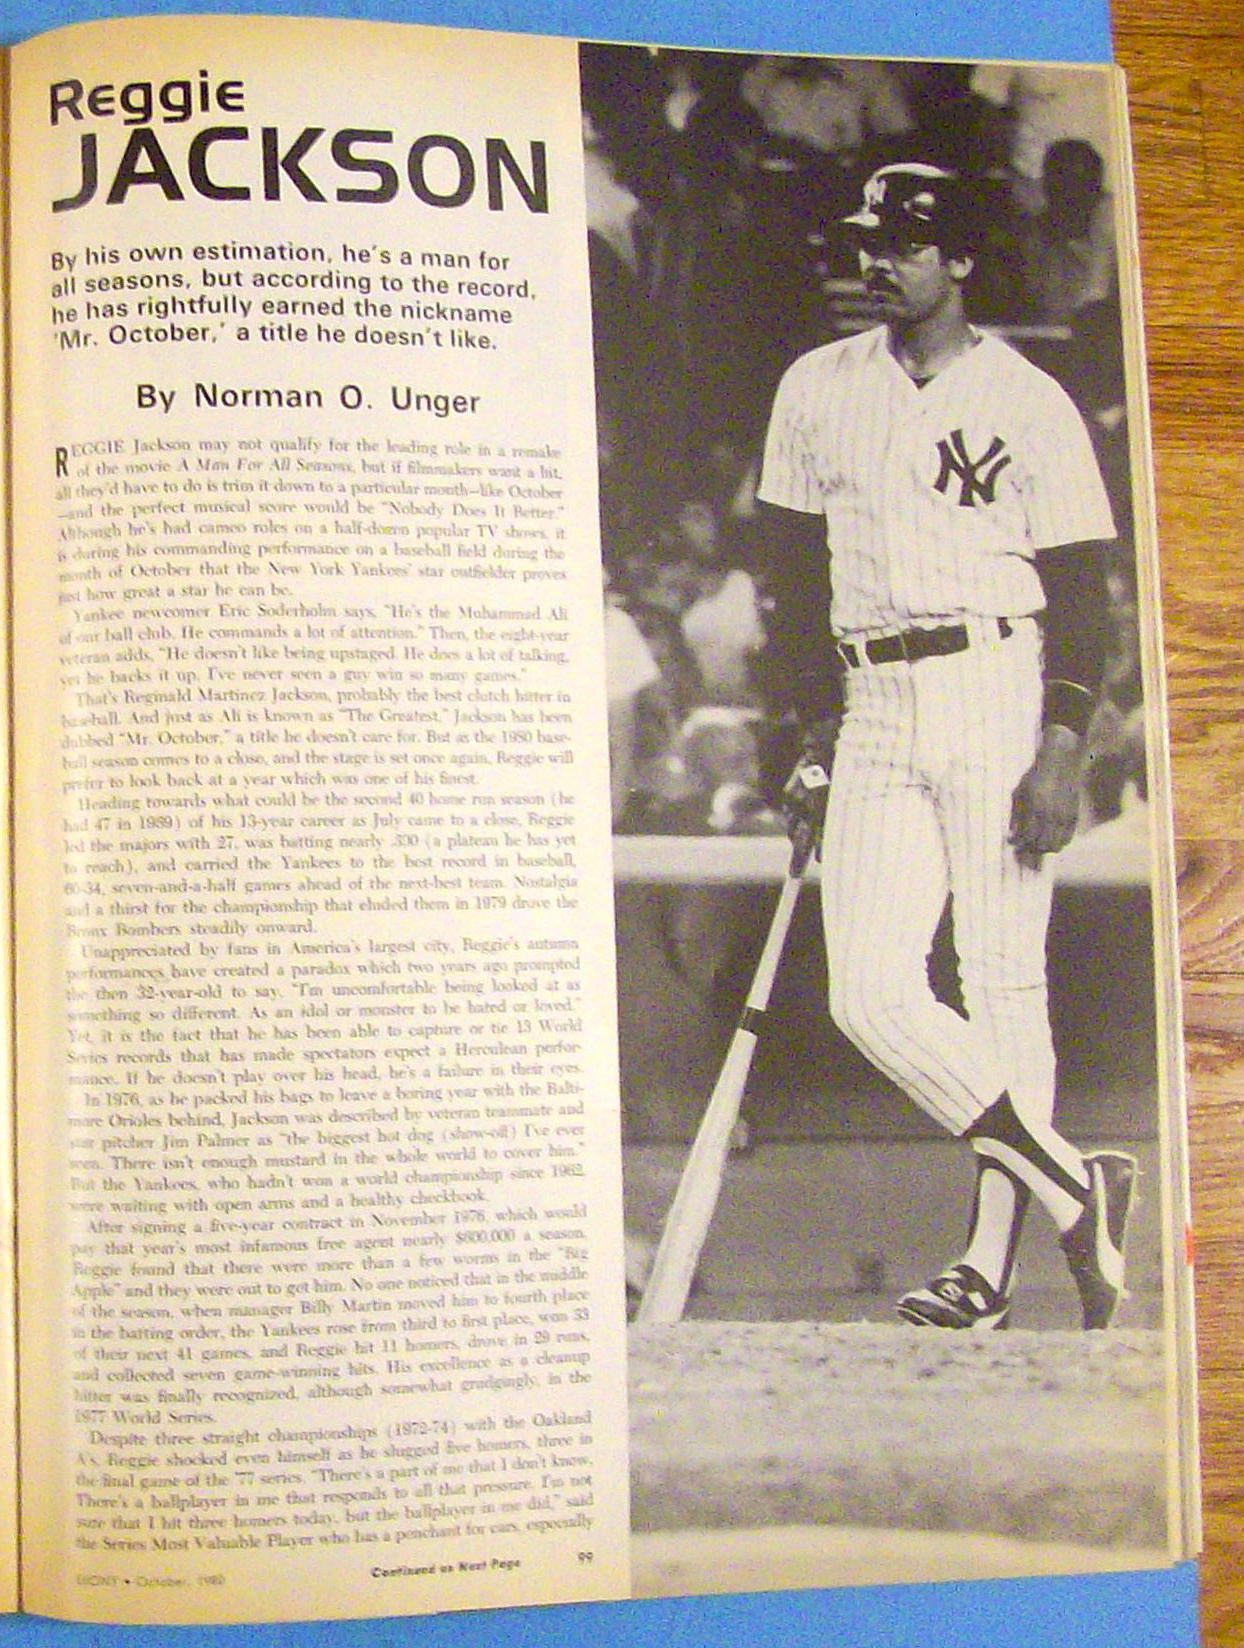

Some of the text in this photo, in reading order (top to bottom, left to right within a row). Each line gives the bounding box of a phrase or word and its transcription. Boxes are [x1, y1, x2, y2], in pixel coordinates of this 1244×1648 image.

[51, 70, 244, 125] Reggie
[53, 126, 549, 213] JACKSON
[51, 241, 510, 272] By his own estimation, he's a man for
[52, 268, 536, 299] all seasons, but according to the record,
[52, 294, 512, 325] he has rightfully earned the nickname
[237, 326, 250, 341] a
[260, 322, 307, 342] title
[317, 324, 345, 343] he
[354, 325, 443, 347] doesn't
[451, 330, 497, 350] like.
[137, 383, 480, 418] By Norman O. Unger
